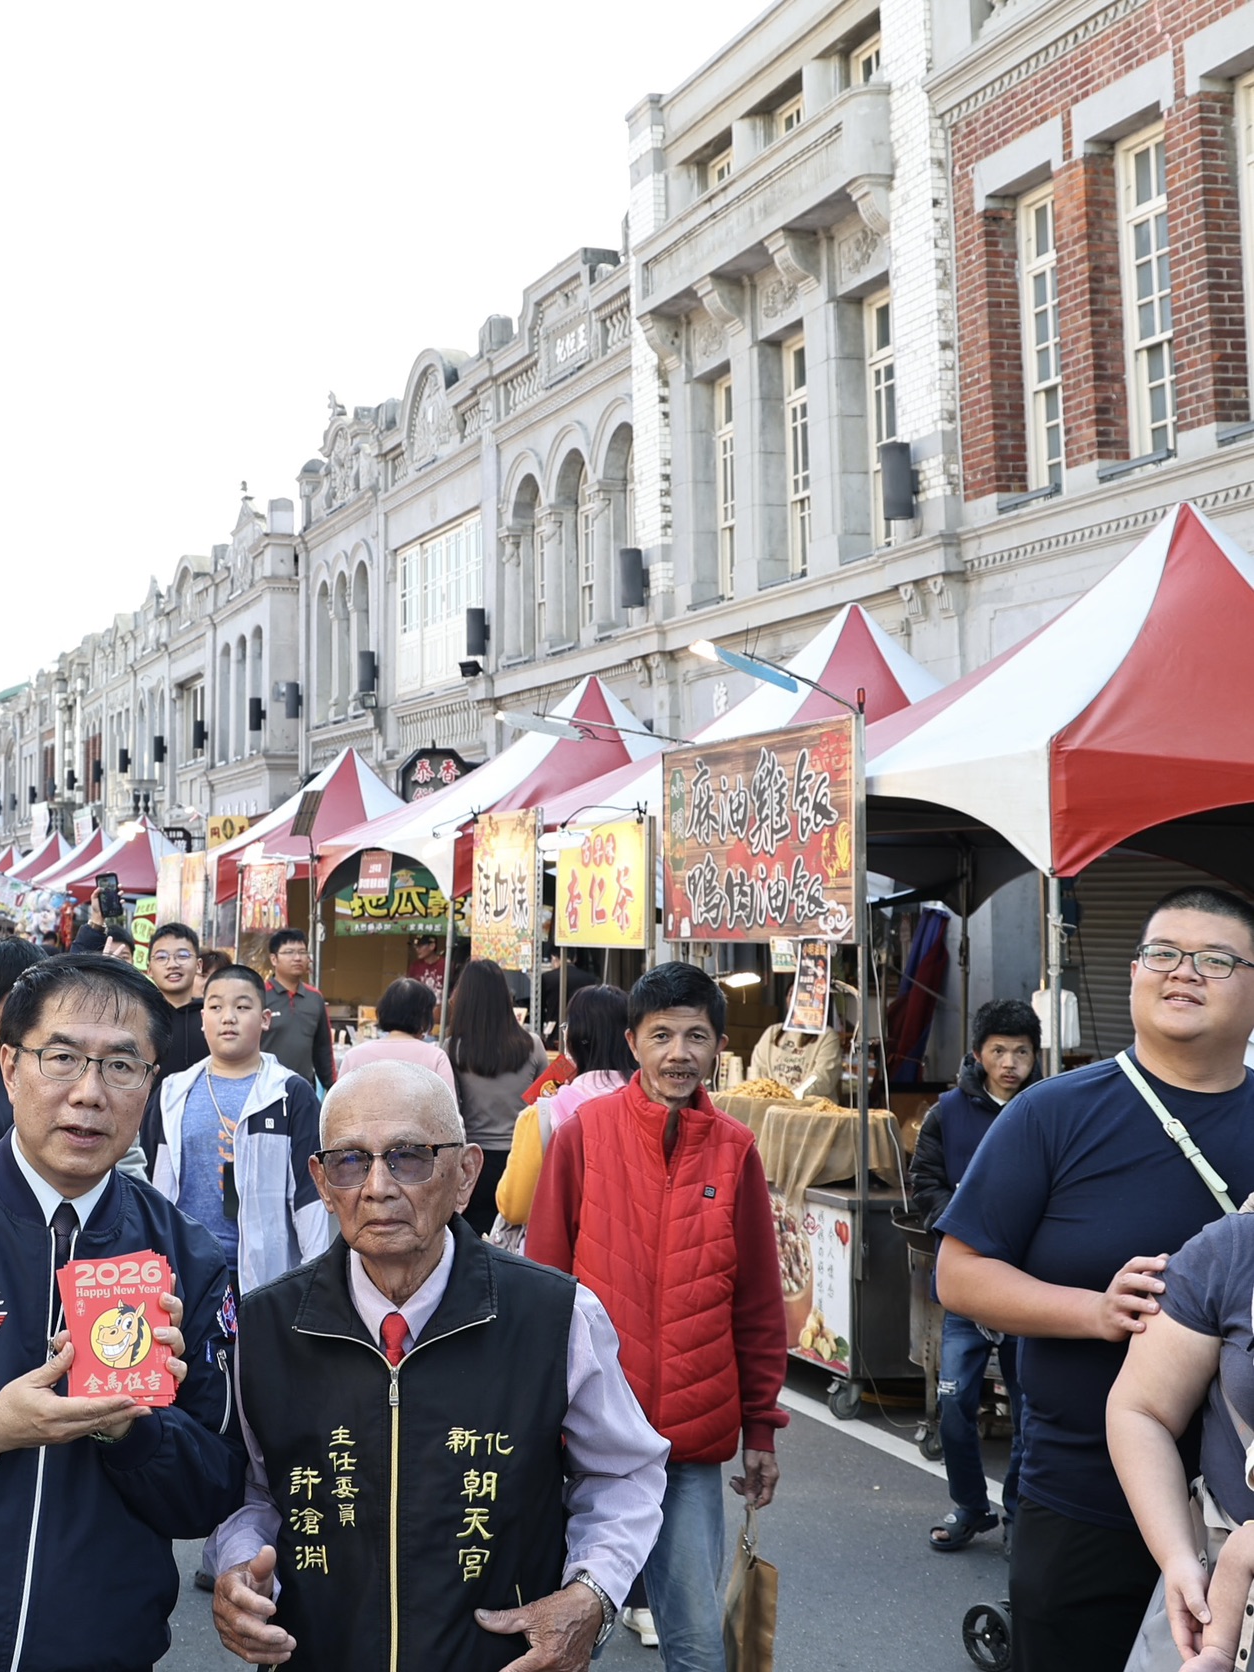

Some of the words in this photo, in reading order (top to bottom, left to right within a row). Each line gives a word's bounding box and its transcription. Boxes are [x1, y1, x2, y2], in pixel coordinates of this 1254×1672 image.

[685, 746, 838, 855] 麻油雞飯
[565, 866, 634, 936] 杏仁茶
[685, 852, 830, 930] 鴨肉油飯
[75, 1260, 163, 1287] 2026
[76, 1286, 111, 1299] Happy
[113, 1285, 136, 1295] New
[139, 1284, 163, 1294] Year
[83, 1369, 163, 1394] 金馬伍吉
[329, 1425, 360, 1528] 主任委員
[445, 1427, 514, 1457] 新化
[289, 1466, 329, 1575] 許滄淵
[456, 1468, 498, 1582] 朝天宮
